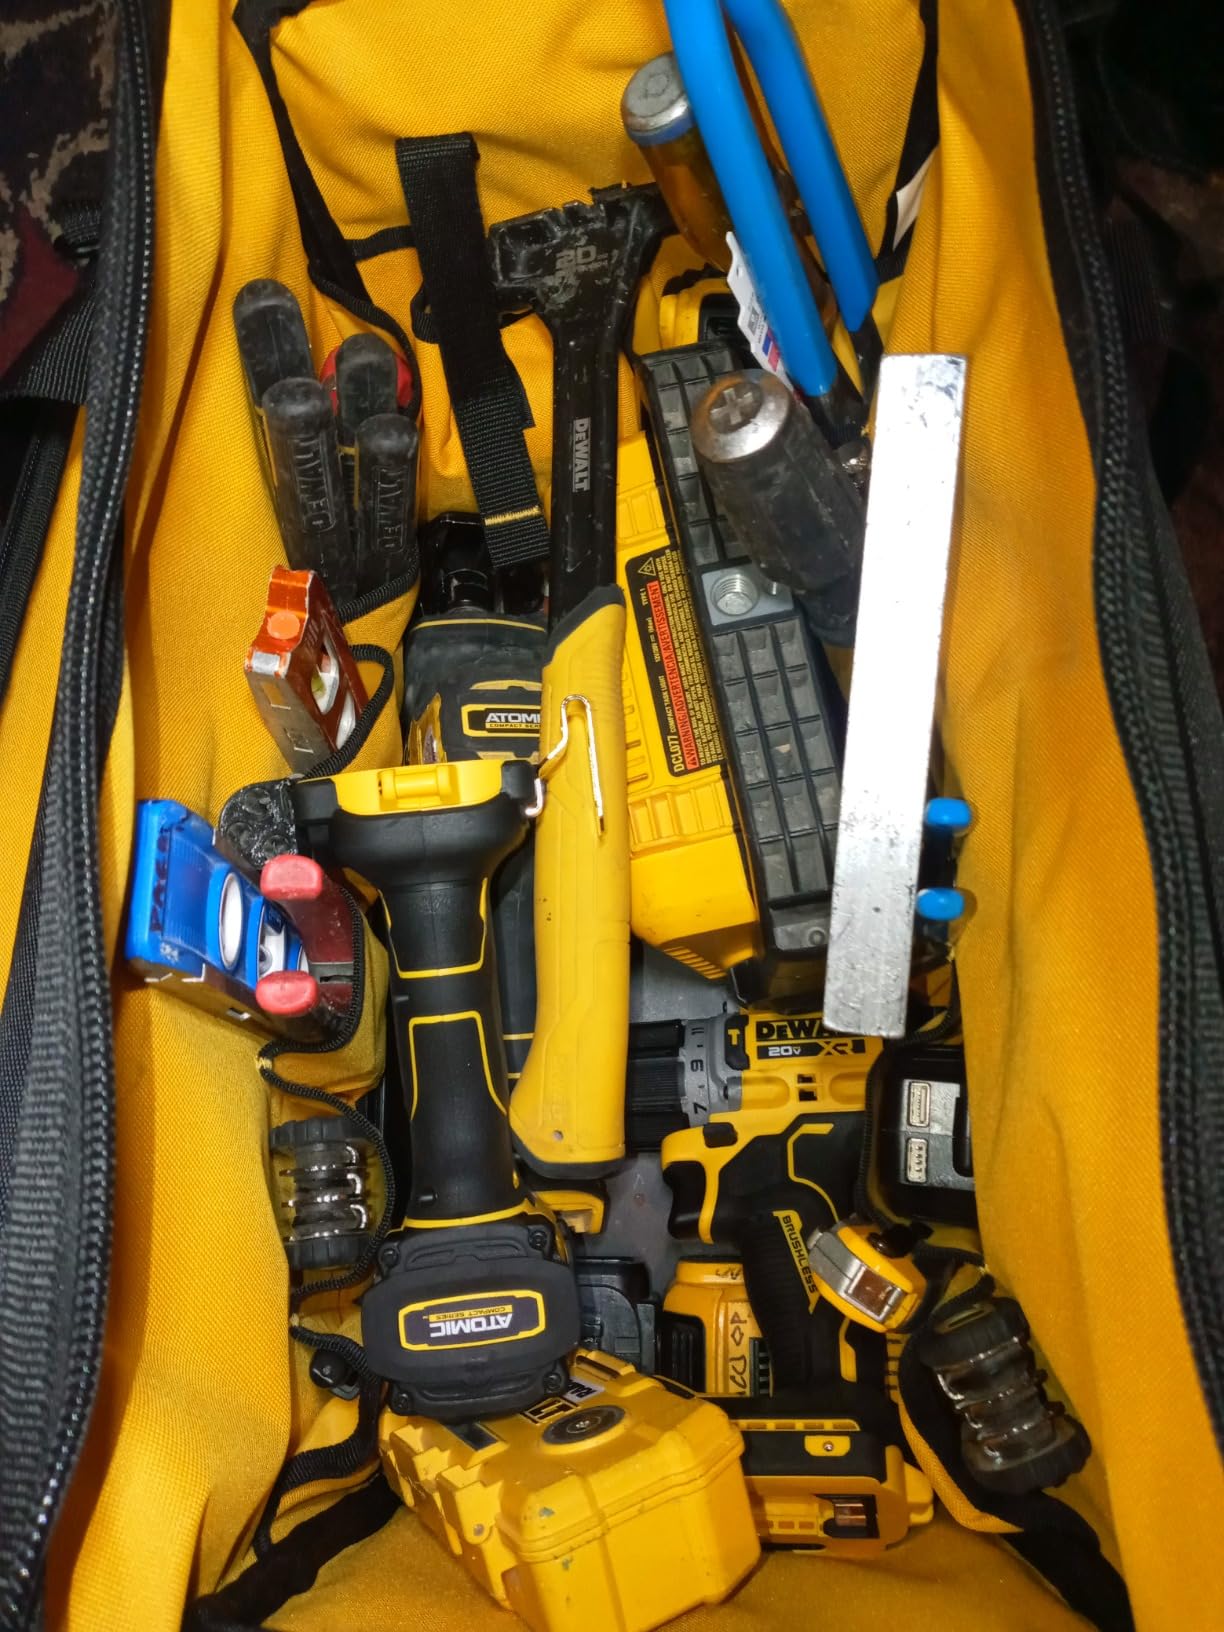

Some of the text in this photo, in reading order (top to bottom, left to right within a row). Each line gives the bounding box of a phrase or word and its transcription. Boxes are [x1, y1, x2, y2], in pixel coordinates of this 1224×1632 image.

[573, 418, 590, 492] DEWALT
[639, 591, 648, 605] TYPE
[649, 583, 694, 758] WARNING/ADVERTENCIA/AVERTISSEMENT
[486, 713, 540, 723] ATOMI
[657, 675, 676, 733] COMPACT TASK LIGHT
[666, 733, 685, 772] DCL077
[782, 1214, 818, 1294] BRUSHLESS
[429, 1313, 513, 1338] ATOMIC
[435, 1306, 506, 1320] COMPACT SERIES
